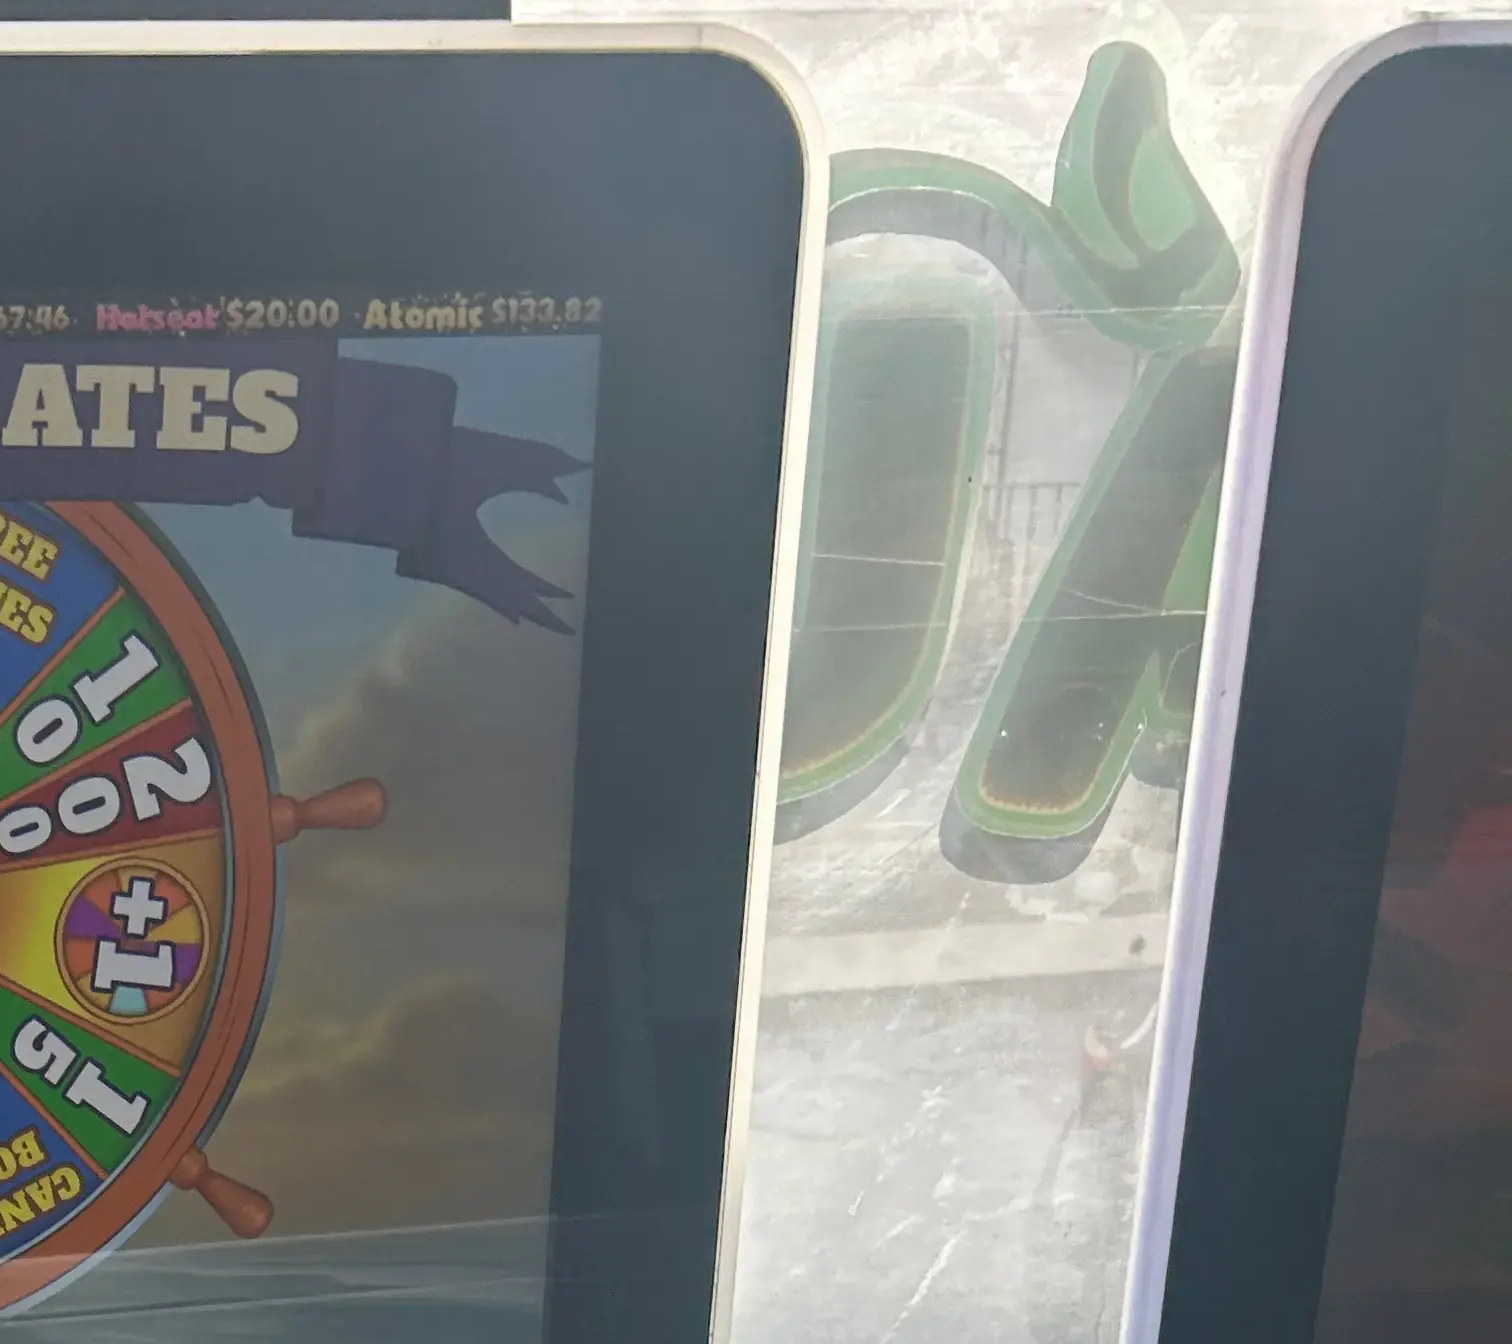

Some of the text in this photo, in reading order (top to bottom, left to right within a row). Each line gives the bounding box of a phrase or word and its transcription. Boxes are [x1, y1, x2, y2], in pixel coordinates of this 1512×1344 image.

[225, 297, 340, 329] $20.00
[363, 300, 482, 331] Atomic
[492, 297, 604, 325] $133.82
[17, 635, 159, 764] 10
[93, 878, 174, 990] +1
[13, 1018, 147, 1134] 15
